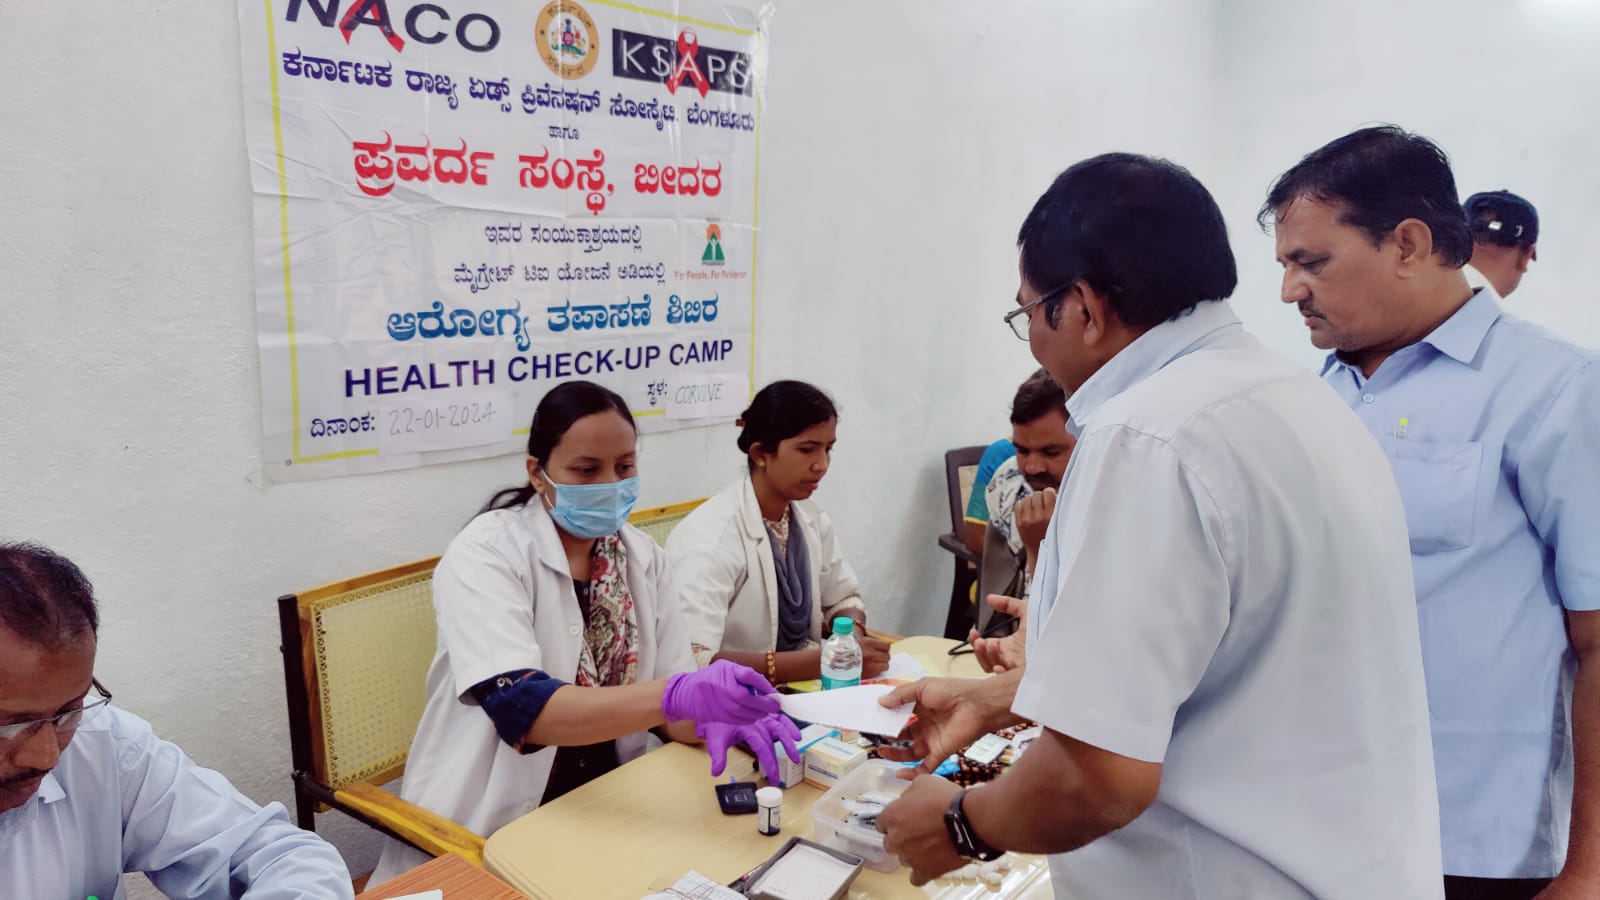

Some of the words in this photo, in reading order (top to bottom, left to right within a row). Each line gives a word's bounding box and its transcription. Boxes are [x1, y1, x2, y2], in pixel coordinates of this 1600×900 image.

[285, 0, 501, 52] NACO
[621, 39, 750, 88] KSAPS
[282, 47, 392, 88] ಕರ್ನಾಟಕ
[405, 70, 459, 110] ರಾಜ್ಯ
[469, 76, 512, 112] ಏಡ್ಸ್
[688, 102, 754, 132] ಬೆಂಗಳೂರು
[549, 125, 580, 141] ಹಾಗೂ
[634, 159, 722, 197] ಬೀದರ
[485, 222, 522, 245] ಇವರ
[557, 262, 610, 281] ಯೋಜನೆ
[618, 262, 665, 287] ಅಡಿಯಲ್ಲಿ
[387, 299, 531, 352] ಆರೋಗ್ಯ
[547, 294, 651, 332] ತಪಾಸಣೆ
[666, 292, 719, 324] ಶಿಬಿರ
[345, 359, 495, 397] HEALTH
[508, 345, 660, 382] CHECK-UP
[669, 339, 733, 365] CAMP
[310, 411, 376, 438] ದಿನಾಂಕ:
[388, 401, 497, 436] 22-01-2024
